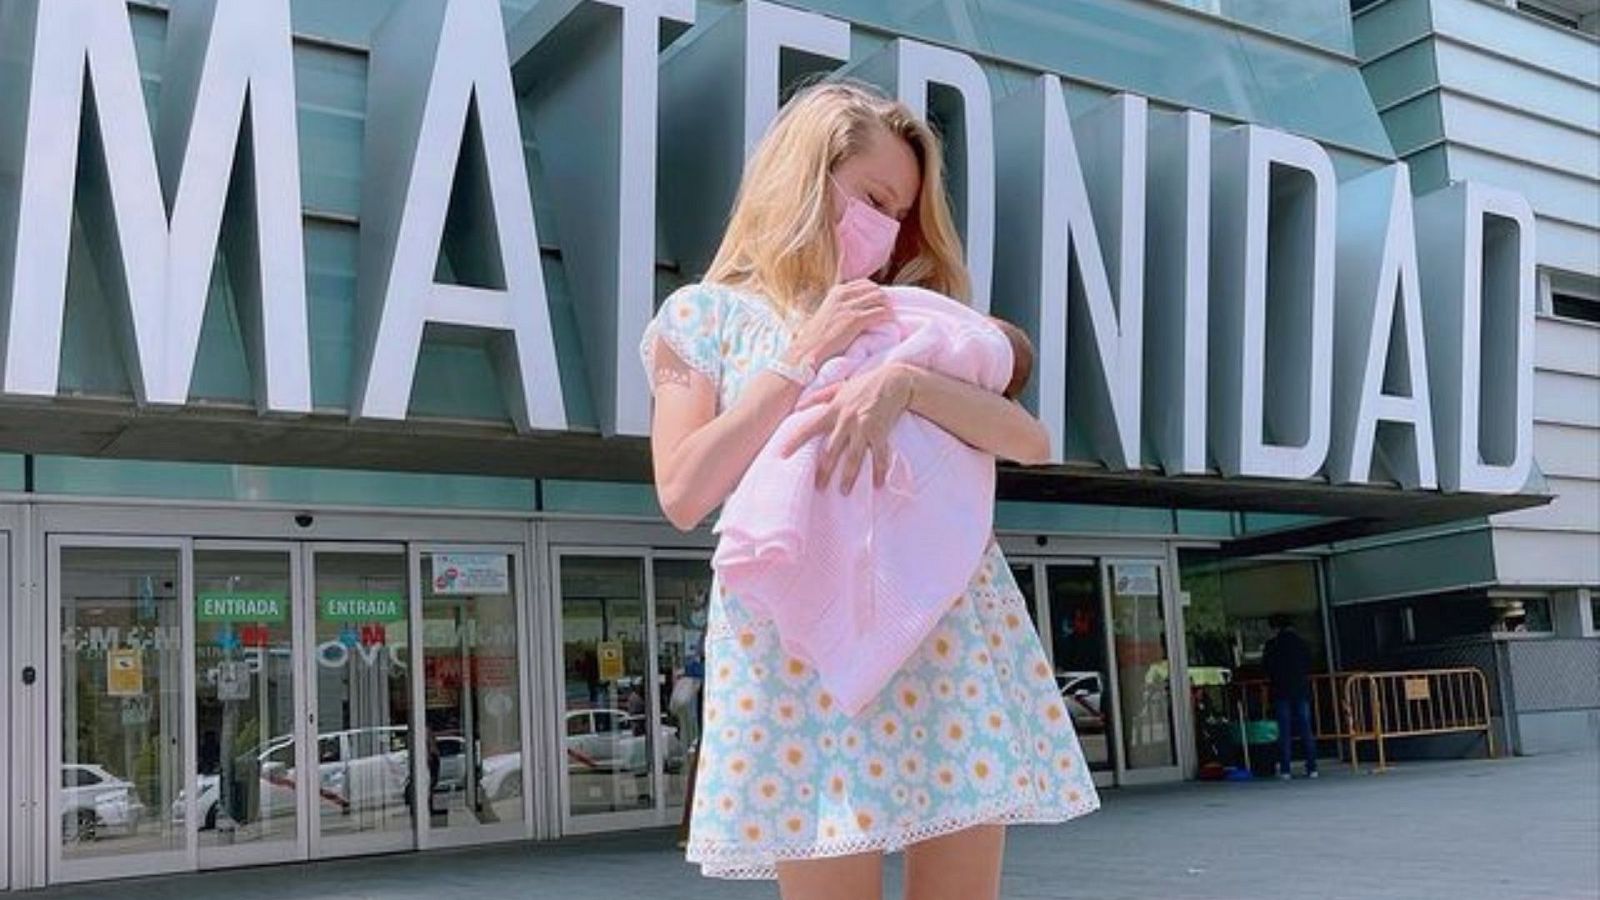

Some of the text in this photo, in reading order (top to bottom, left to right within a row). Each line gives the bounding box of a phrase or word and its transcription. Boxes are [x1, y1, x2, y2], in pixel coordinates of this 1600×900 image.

[4, 0, 1536, 494] MATNIDAD
[204, 599, 279, 616] ENTRADA
[328, 599, 397, 616] ENTRADA
